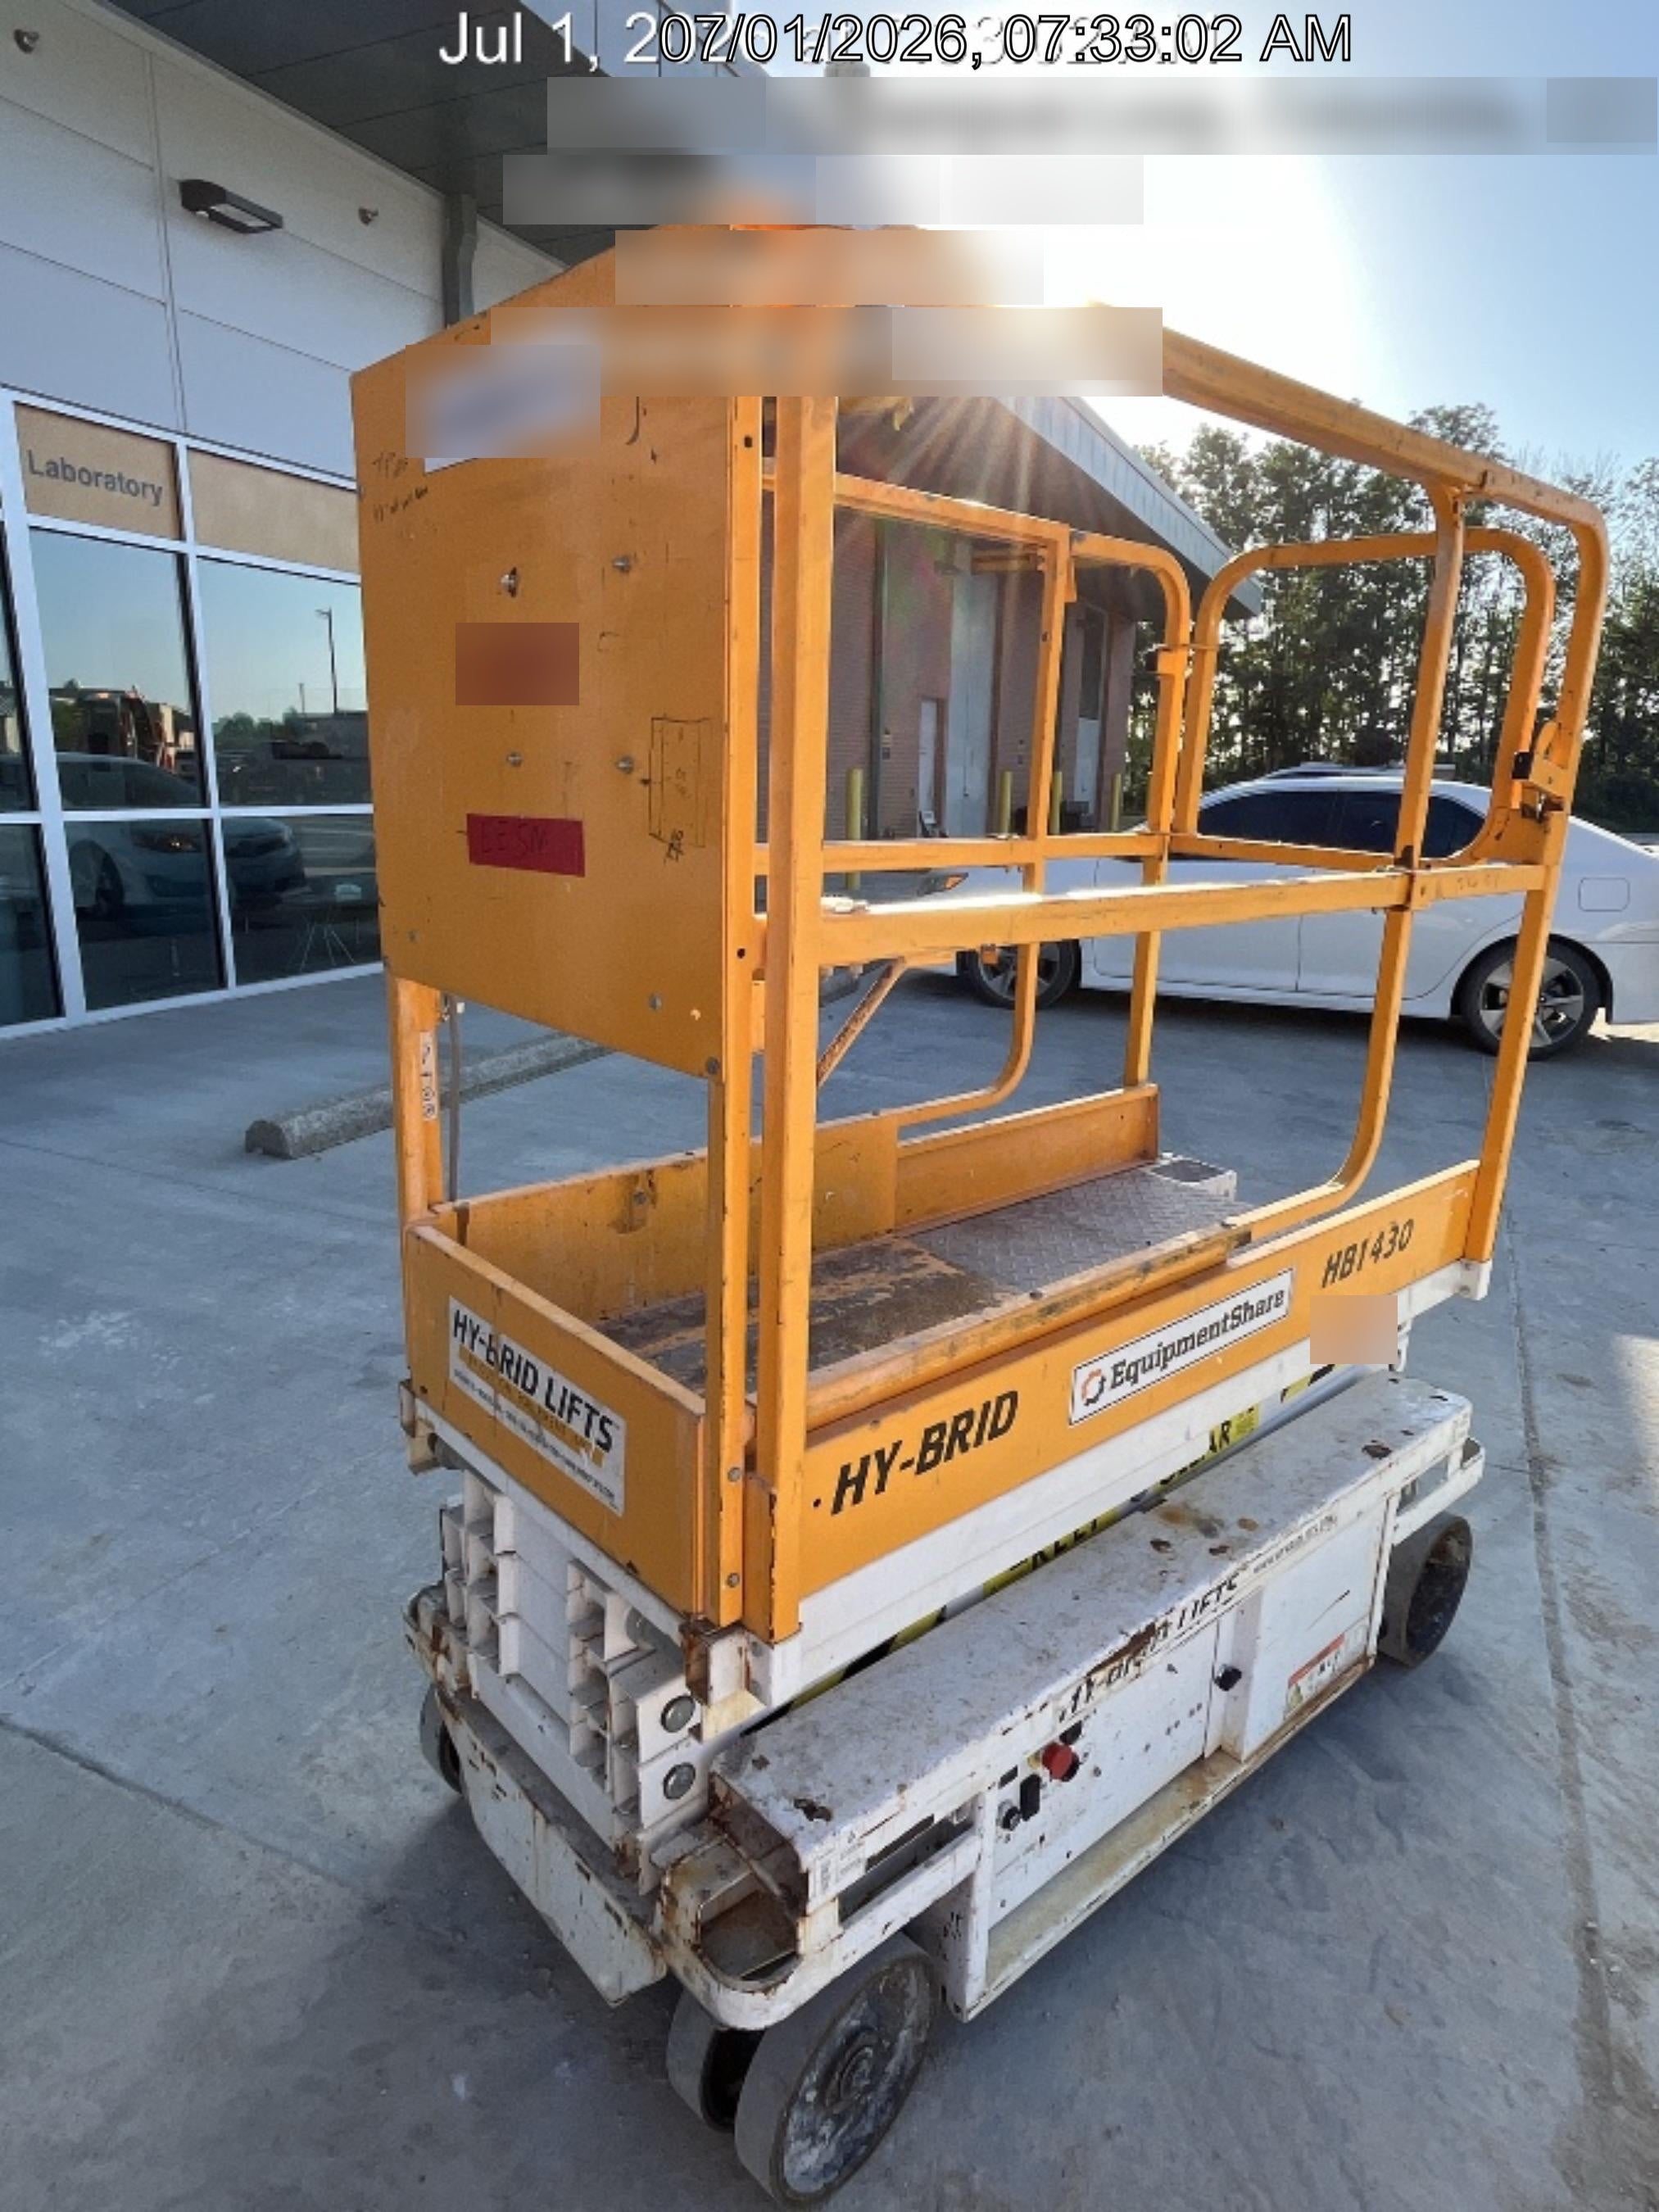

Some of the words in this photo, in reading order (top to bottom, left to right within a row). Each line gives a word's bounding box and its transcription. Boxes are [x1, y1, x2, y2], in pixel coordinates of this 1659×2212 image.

[27, 450, 163, 506] Laboratory
[1321, 1218, 1414, 1289] HB1430
[1109, 1289, 1285, 1389] EquipmentShare
[544, 1376, 614, 1453] LIFTS
[831, 1390, 1018, 1516] HY-BRID
